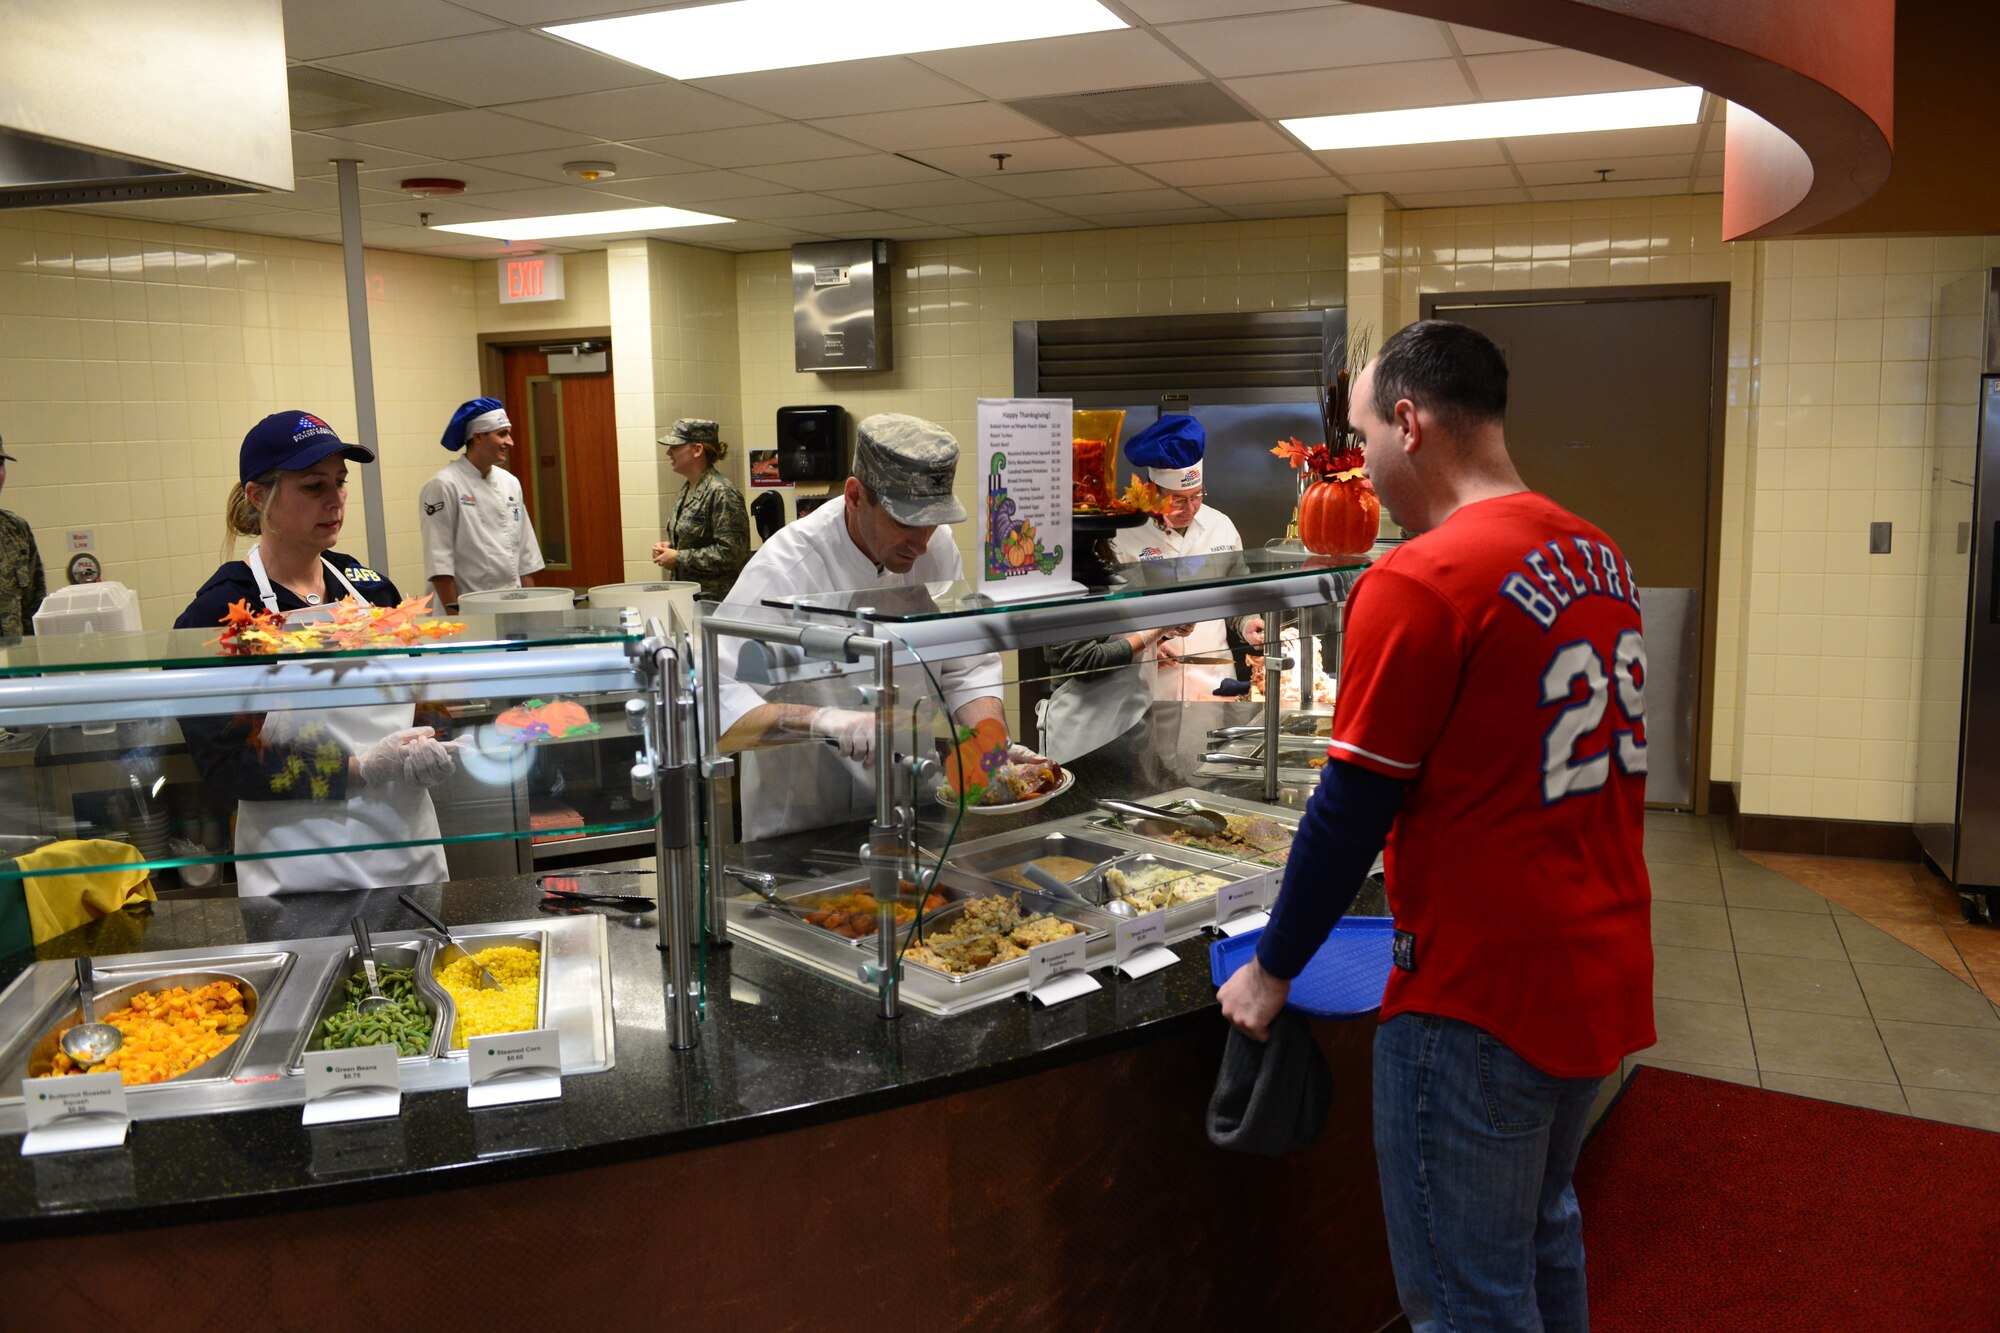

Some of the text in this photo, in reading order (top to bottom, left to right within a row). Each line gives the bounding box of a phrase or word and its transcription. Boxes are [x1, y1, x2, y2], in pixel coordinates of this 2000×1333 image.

[507, 260, 545, 297] EXIT
[1019, 411, 1051, 420] Thanksgiving!
[1499, 535, 1641, 634] BELTRE
[1536, 628, 1648, 807] 29
[1047, 955, 1062, 963] Candied
[497, 1048, 524, 1056] Steamed
[48, 1089, 111, 1100] Butternut Roasted
[63, 1099, 90, 1107] Squash
